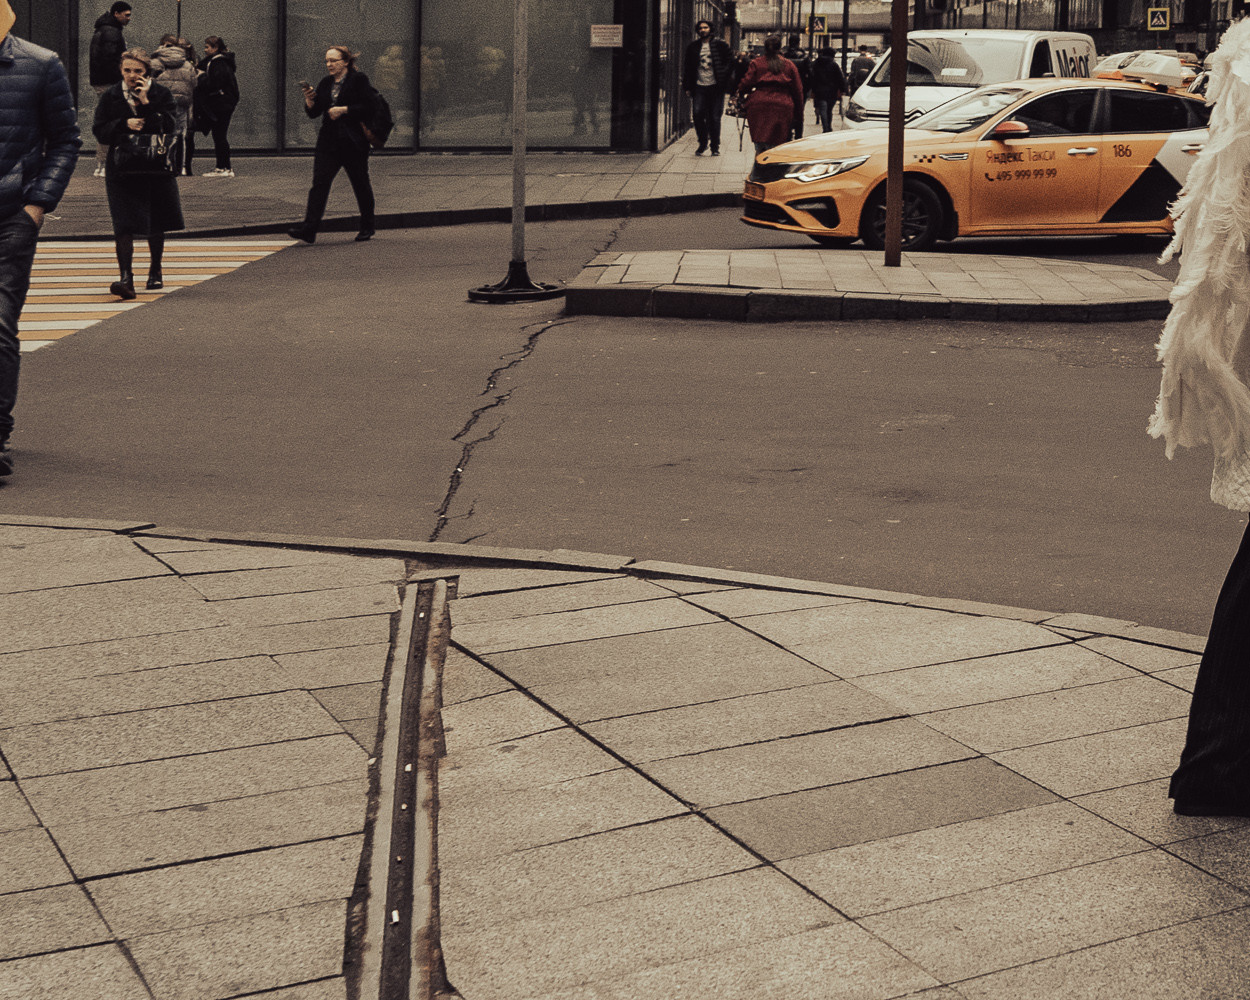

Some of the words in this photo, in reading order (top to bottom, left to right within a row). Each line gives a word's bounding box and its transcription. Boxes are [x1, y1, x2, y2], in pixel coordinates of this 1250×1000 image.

[986, 150, 1024, 164] Яндекс
[1026, 147, 1056, 162] Такси
[1113, 144, 1132, 158] 186
[996, 170, 1012, 181] 495
[1015, 169, 1031, 180] 999
[1033, 168, 1044, 179] 99
[1046, 168, 1057, 178] 99
